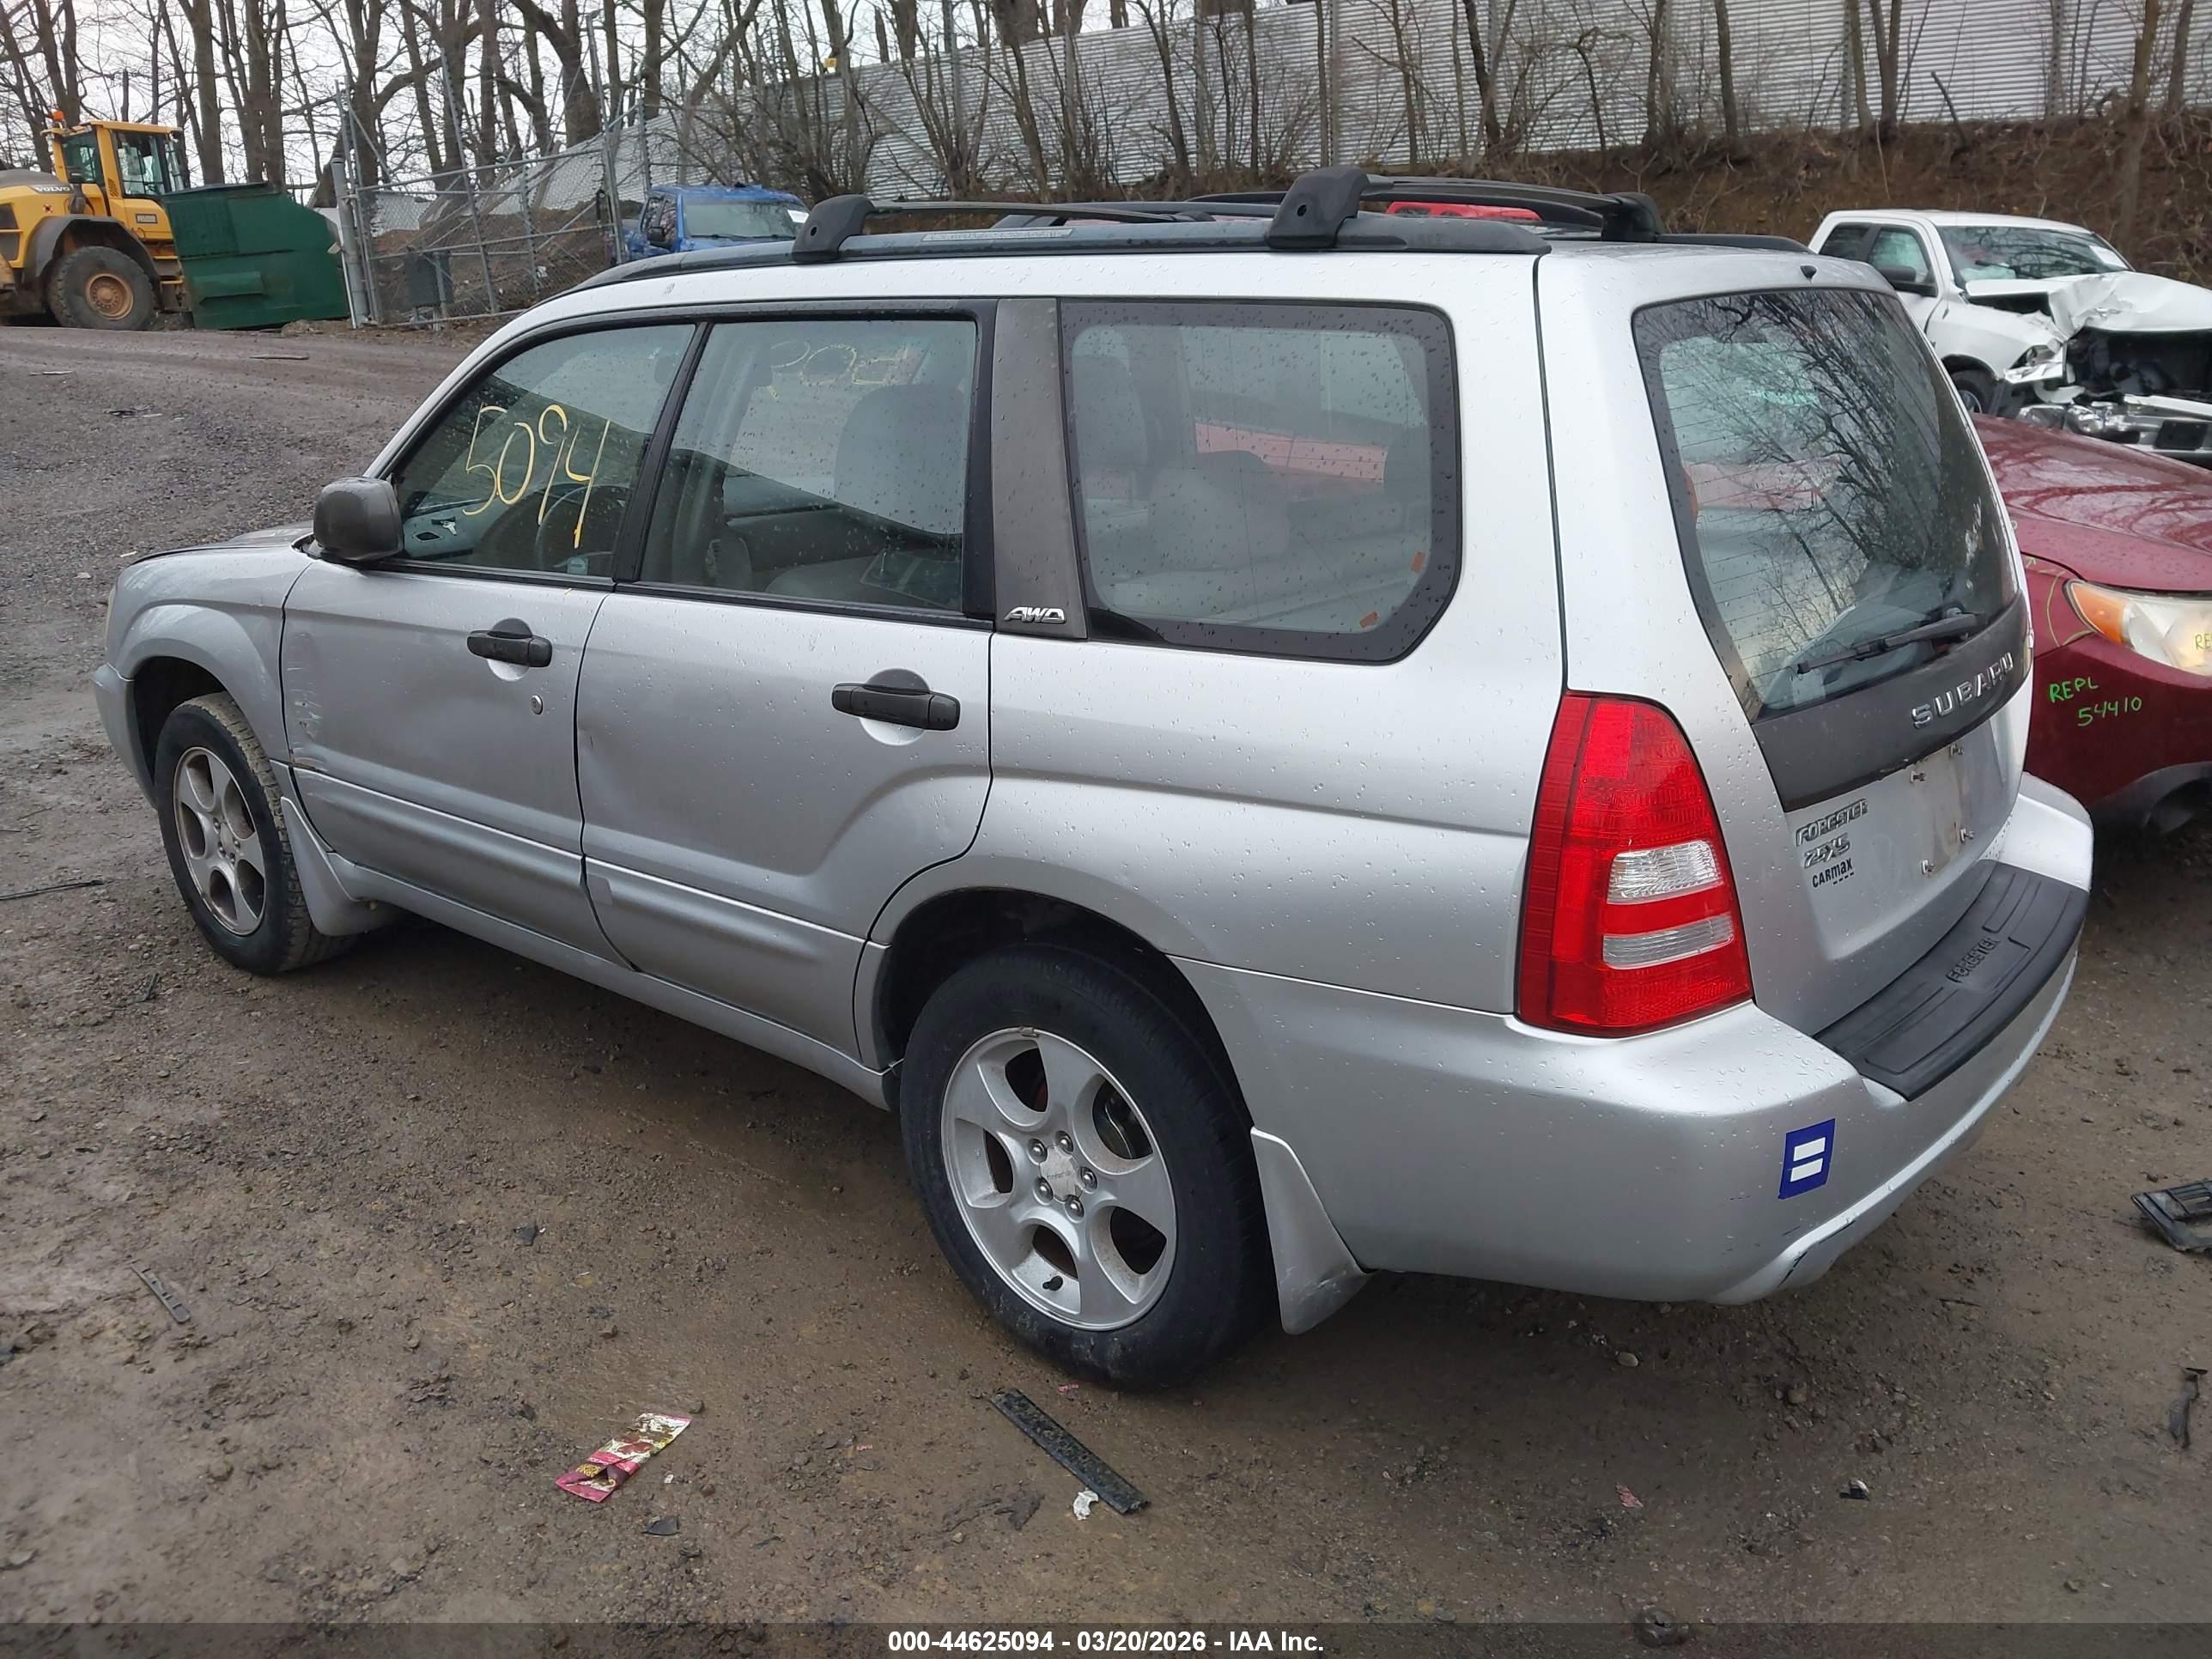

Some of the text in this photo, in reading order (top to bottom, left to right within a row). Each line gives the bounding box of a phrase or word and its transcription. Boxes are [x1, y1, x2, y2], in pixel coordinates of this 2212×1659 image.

[462, 402, 611, 550] 5094
[1003, 606, 1065, 623] AWD
[1911, 652, 2014, 729] SUBARU
[2050, 677, 2100, 702] REPL
[2077, 696, 2142, 726] 54410
[1796, 798, 1869, 847] FORESTER
[1945, 936, 2002, 983] FORESTER
